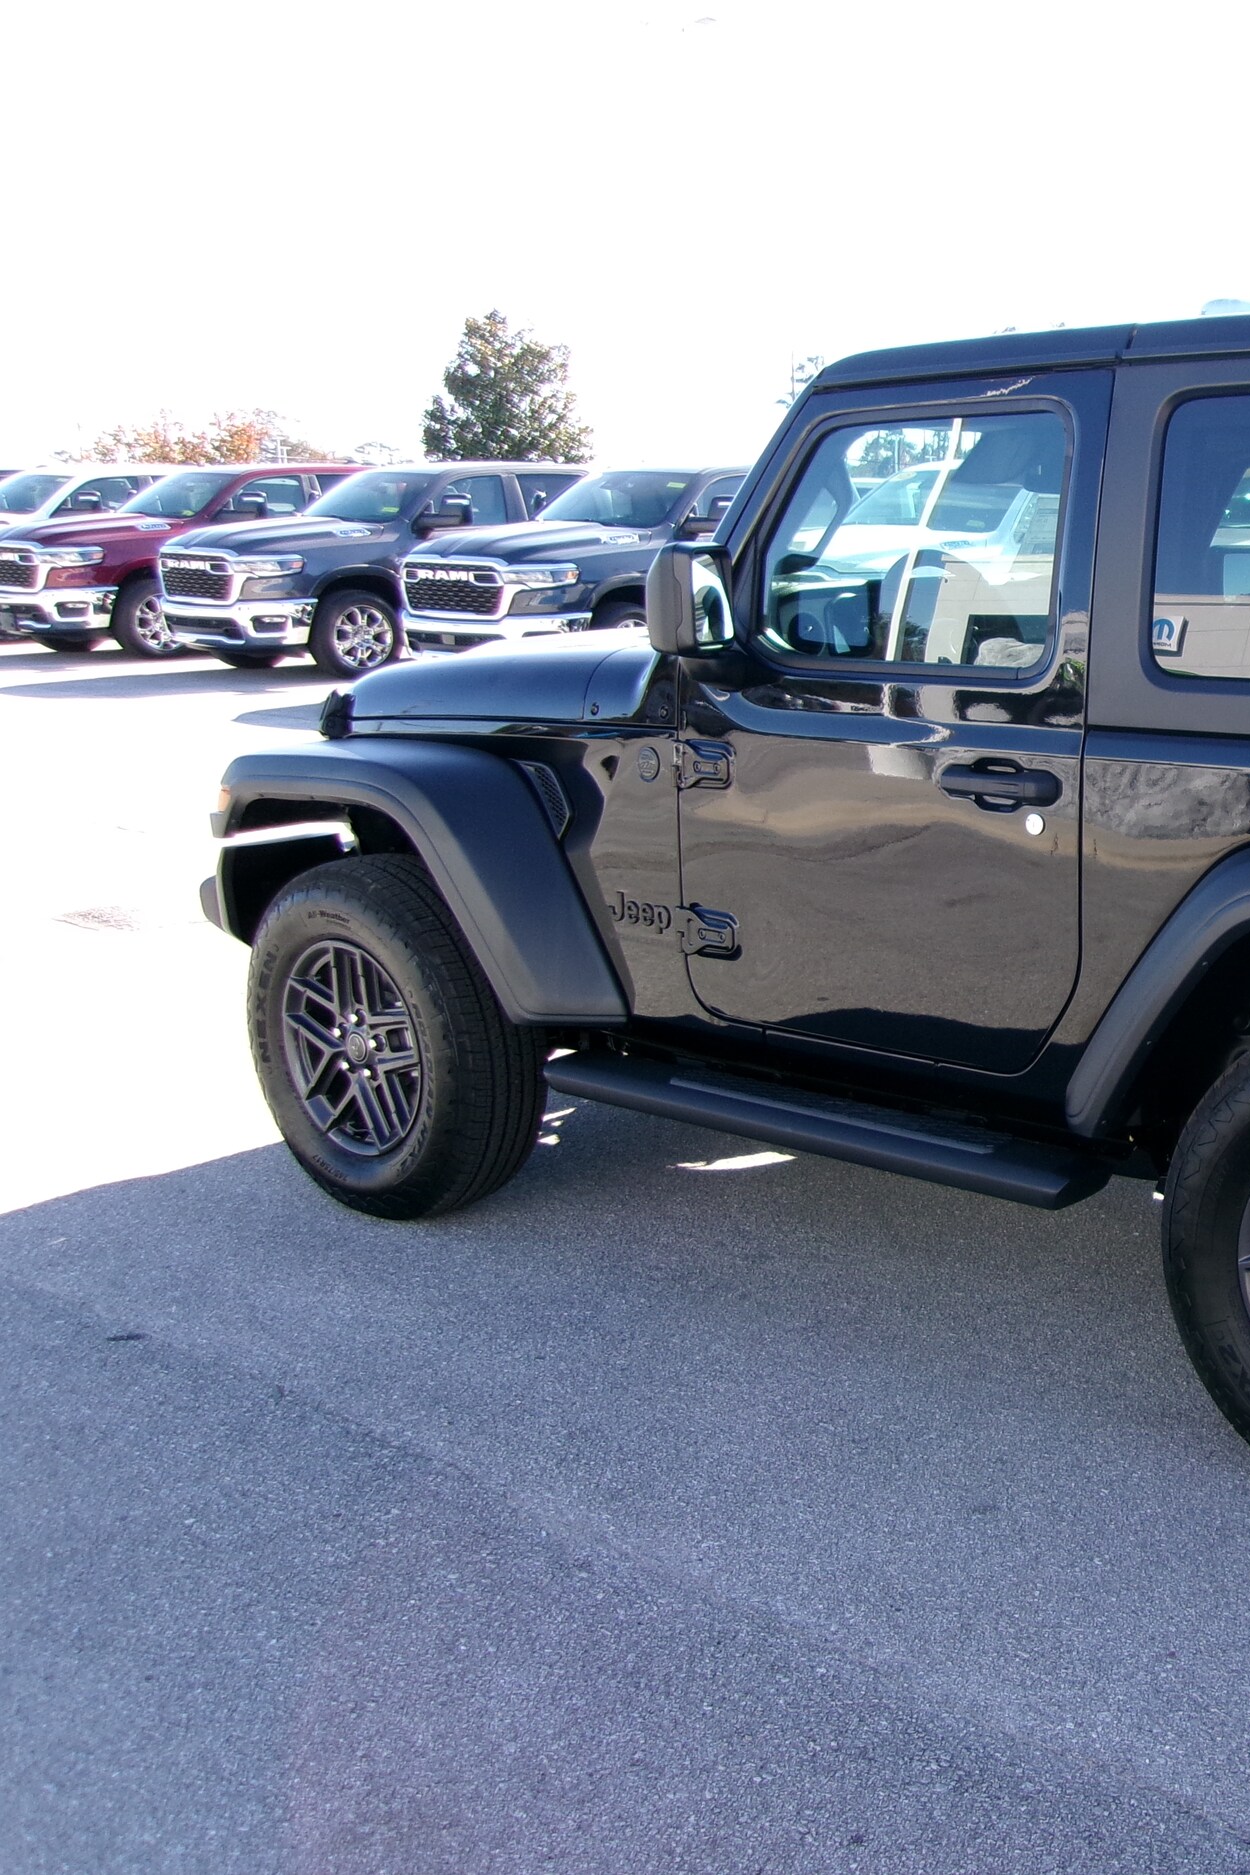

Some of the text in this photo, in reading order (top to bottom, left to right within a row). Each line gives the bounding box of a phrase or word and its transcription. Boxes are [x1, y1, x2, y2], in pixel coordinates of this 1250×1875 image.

[167, 559, 207, 572] RAM
[418, 568, 470, 583] RAM
[608, 891, 671, 934] Jeep
[255, 951, 278, 1064] NEXEN
